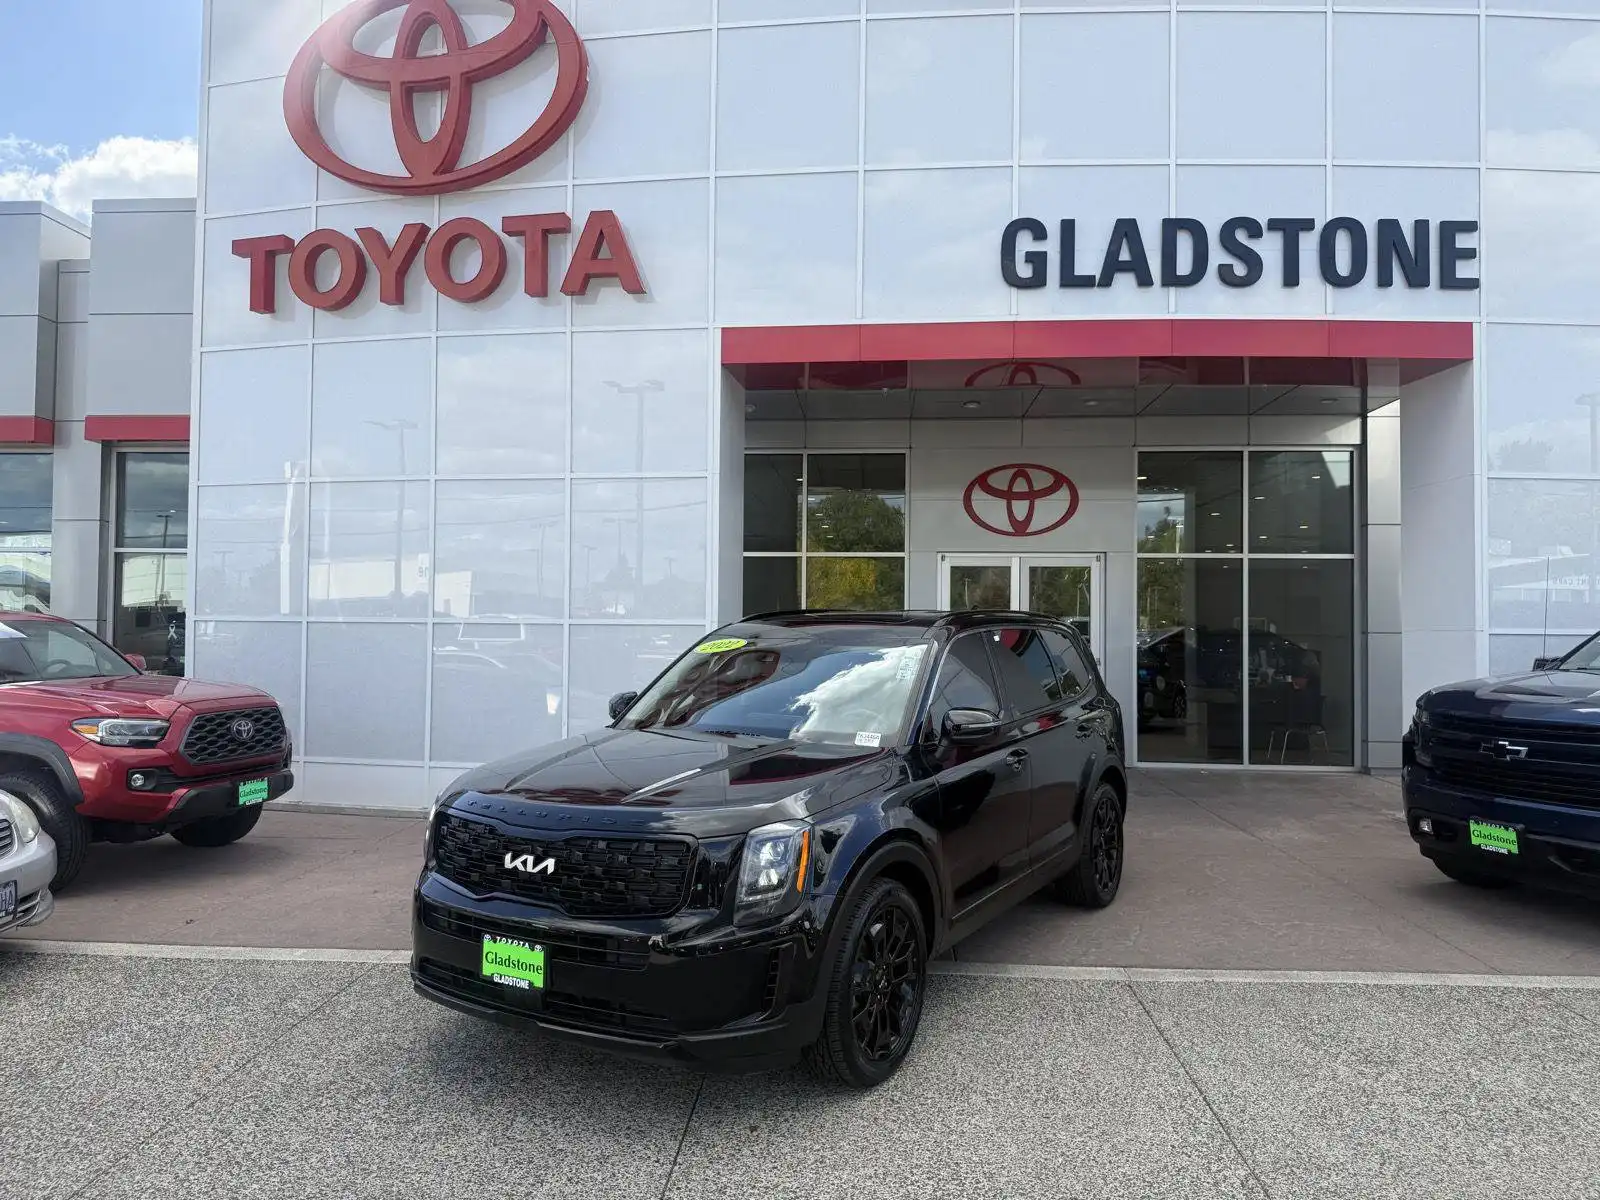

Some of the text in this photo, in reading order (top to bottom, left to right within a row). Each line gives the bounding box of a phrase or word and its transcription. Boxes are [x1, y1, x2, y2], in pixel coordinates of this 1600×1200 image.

[1000, 216, 1479, 290] GLADSTONE
[232, 210, 647, 314] TOYOTA
[240, 787, 267, 798] Gladstone
[1472, 829, 1517, 846] Gladstone
[496, 936, 530, 950] TOYOTA
[484, 951, 543, 975] Gladstone
[493, 973, 530, 989] GLADSTONE
